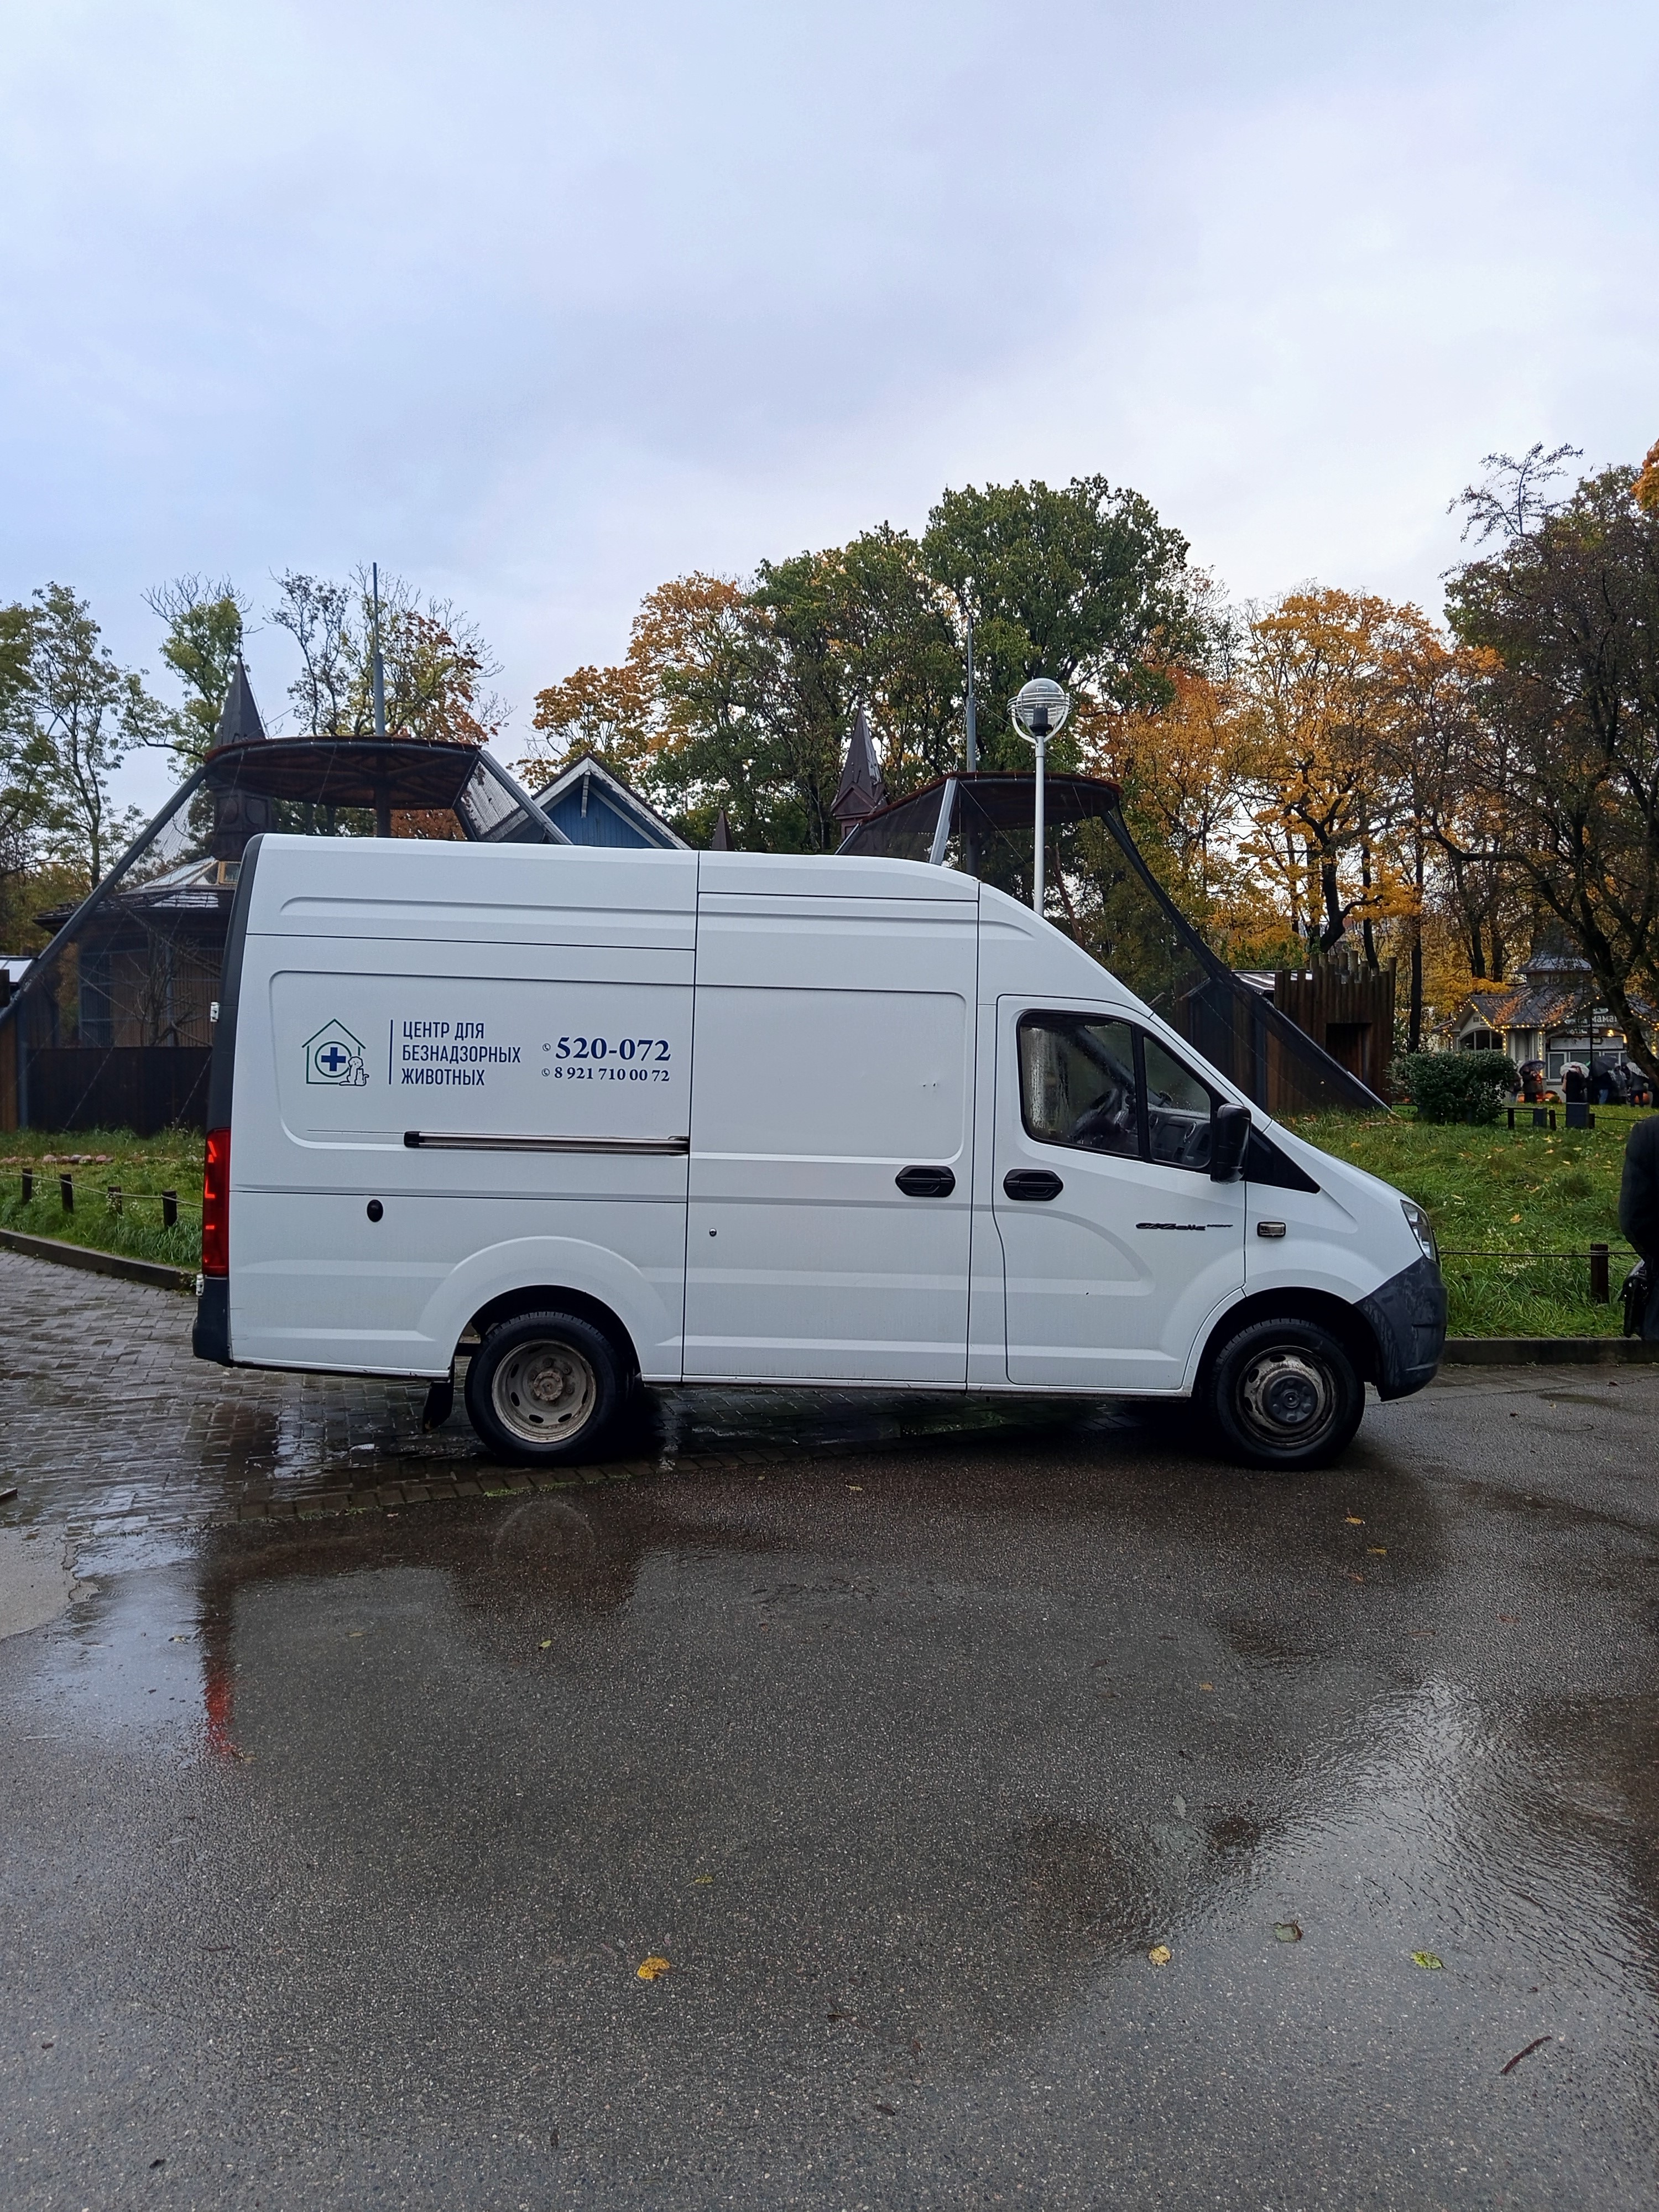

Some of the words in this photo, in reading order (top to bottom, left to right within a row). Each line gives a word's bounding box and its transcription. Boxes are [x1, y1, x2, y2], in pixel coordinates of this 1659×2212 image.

[403, 1021, 450, 1040] ЦЕНТР
[454, 1022, 484, 1041] ДЛЯ
[402, 1045, 521, 1065] БЕЗНАДЗОРНЫХ
[555, 1037, 671, 1061] 520-072
[401, 1068, 485, 1086] ЖИВОТНЫХ
[554, 1066, 563, 1079] 8
[567, 1067, 593, 1079] 921
[598, 1068, 626, 1081] 710
[629, 1069, 648, 1081] 00
[651, 1070, 670, 1082] 72
